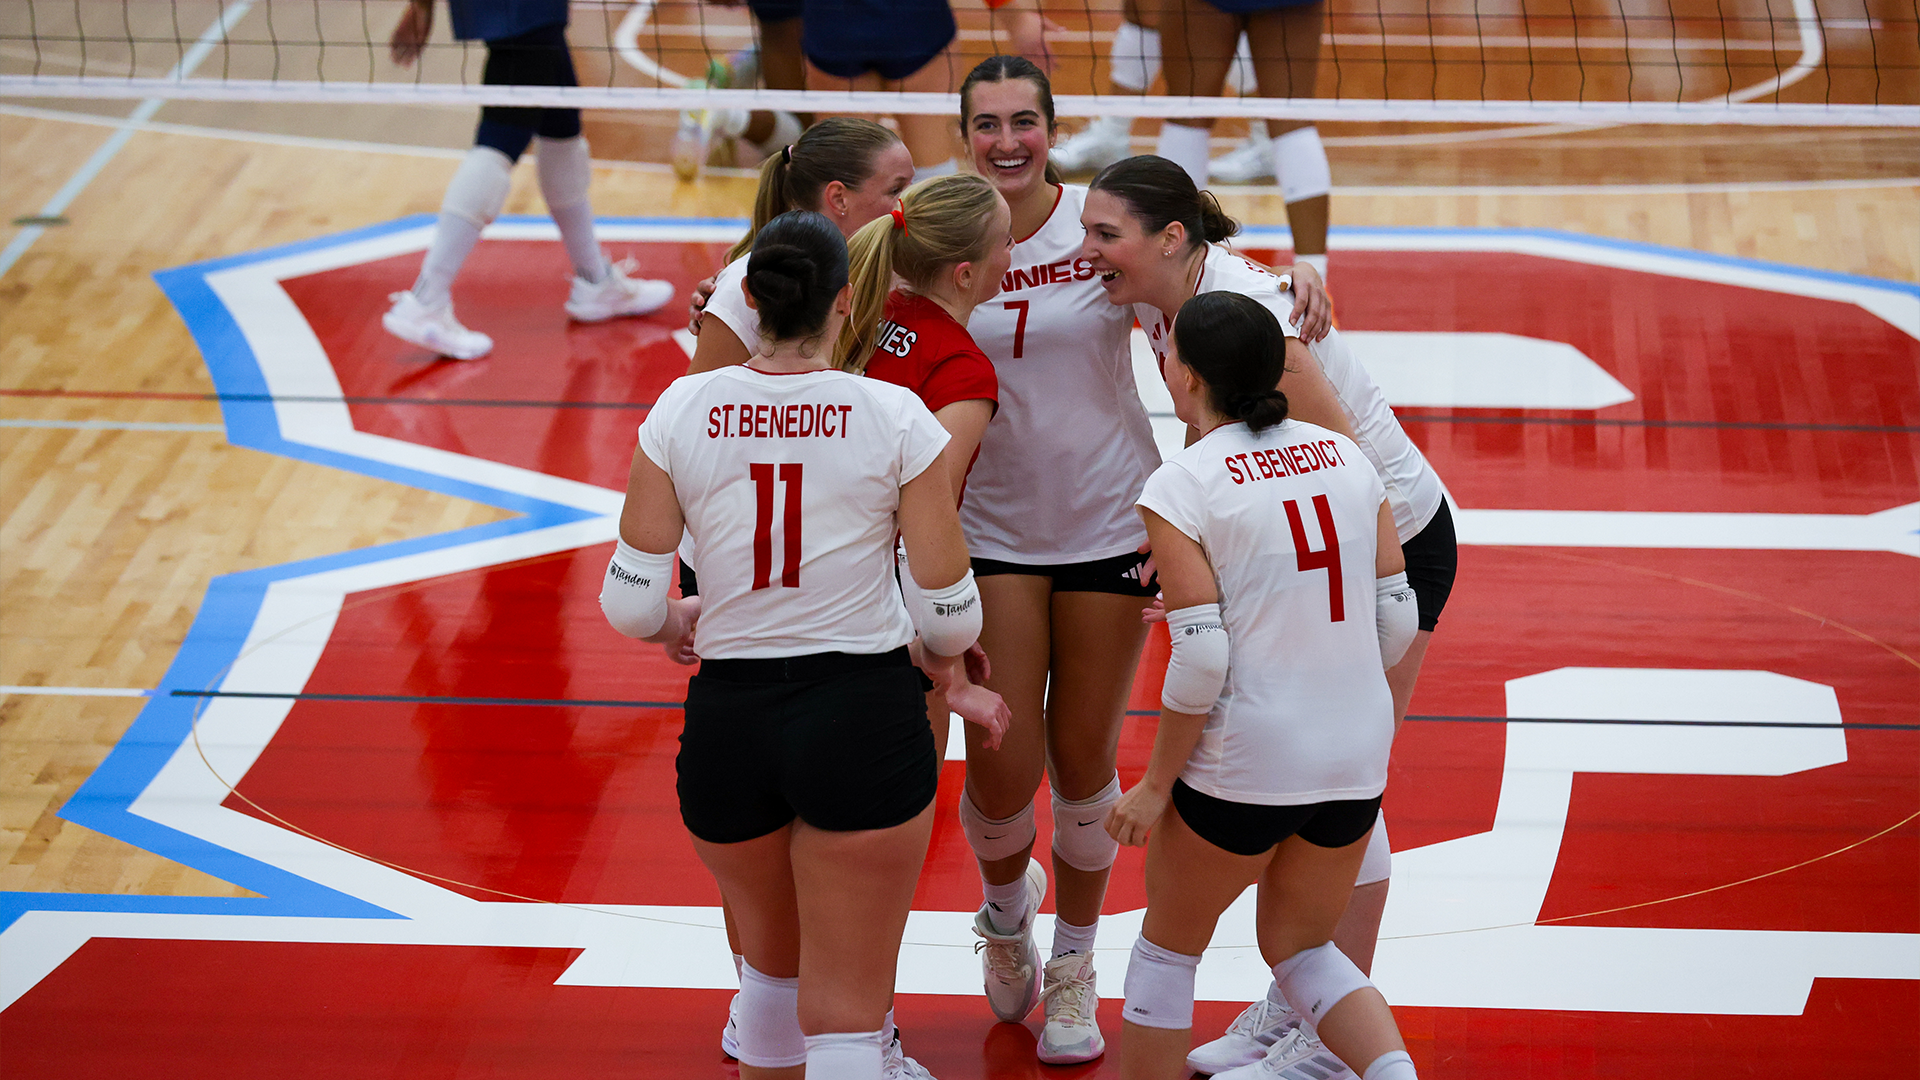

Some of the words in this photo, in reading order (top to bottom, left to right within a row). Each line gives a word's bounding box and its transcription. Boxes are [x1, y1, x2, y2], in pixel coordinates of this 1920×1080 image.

[1003, 299, 1029, 359] 7
[749, 462, 803, 591] 11
[1282, 494, 1345, 623] 4
